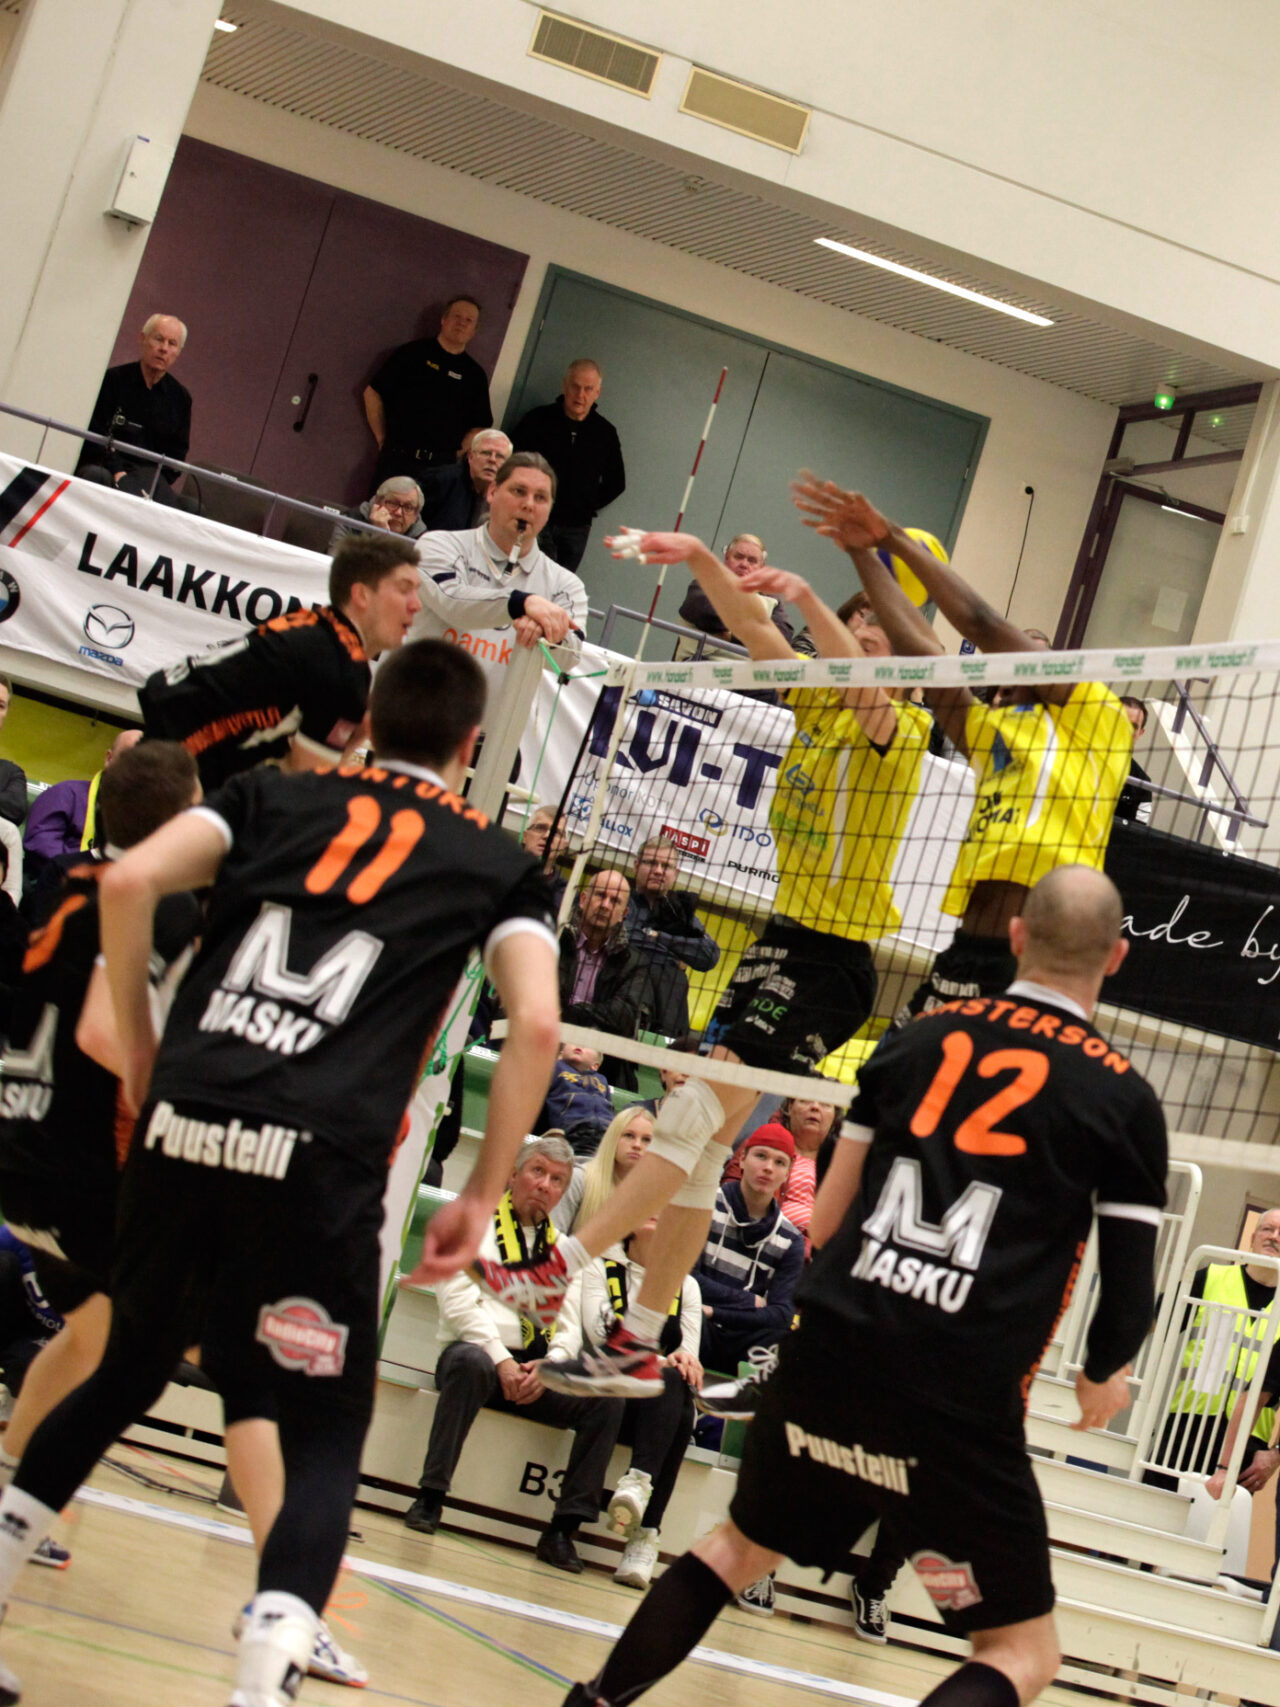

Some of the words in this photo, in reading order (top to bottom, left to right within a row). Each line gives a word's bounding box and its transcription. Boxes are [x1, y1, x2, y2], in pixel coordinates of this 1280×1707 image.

[304, 795, 426, 905] 11
[732, 825, 772, 848] IDO
[910, 1031, 1050, 1157] 12
[144, 1100, 298, 1181] Puustelli
[850, 1237, 975, 1315] MASKU
[784, 1421, 909, 1496] Puustelli
